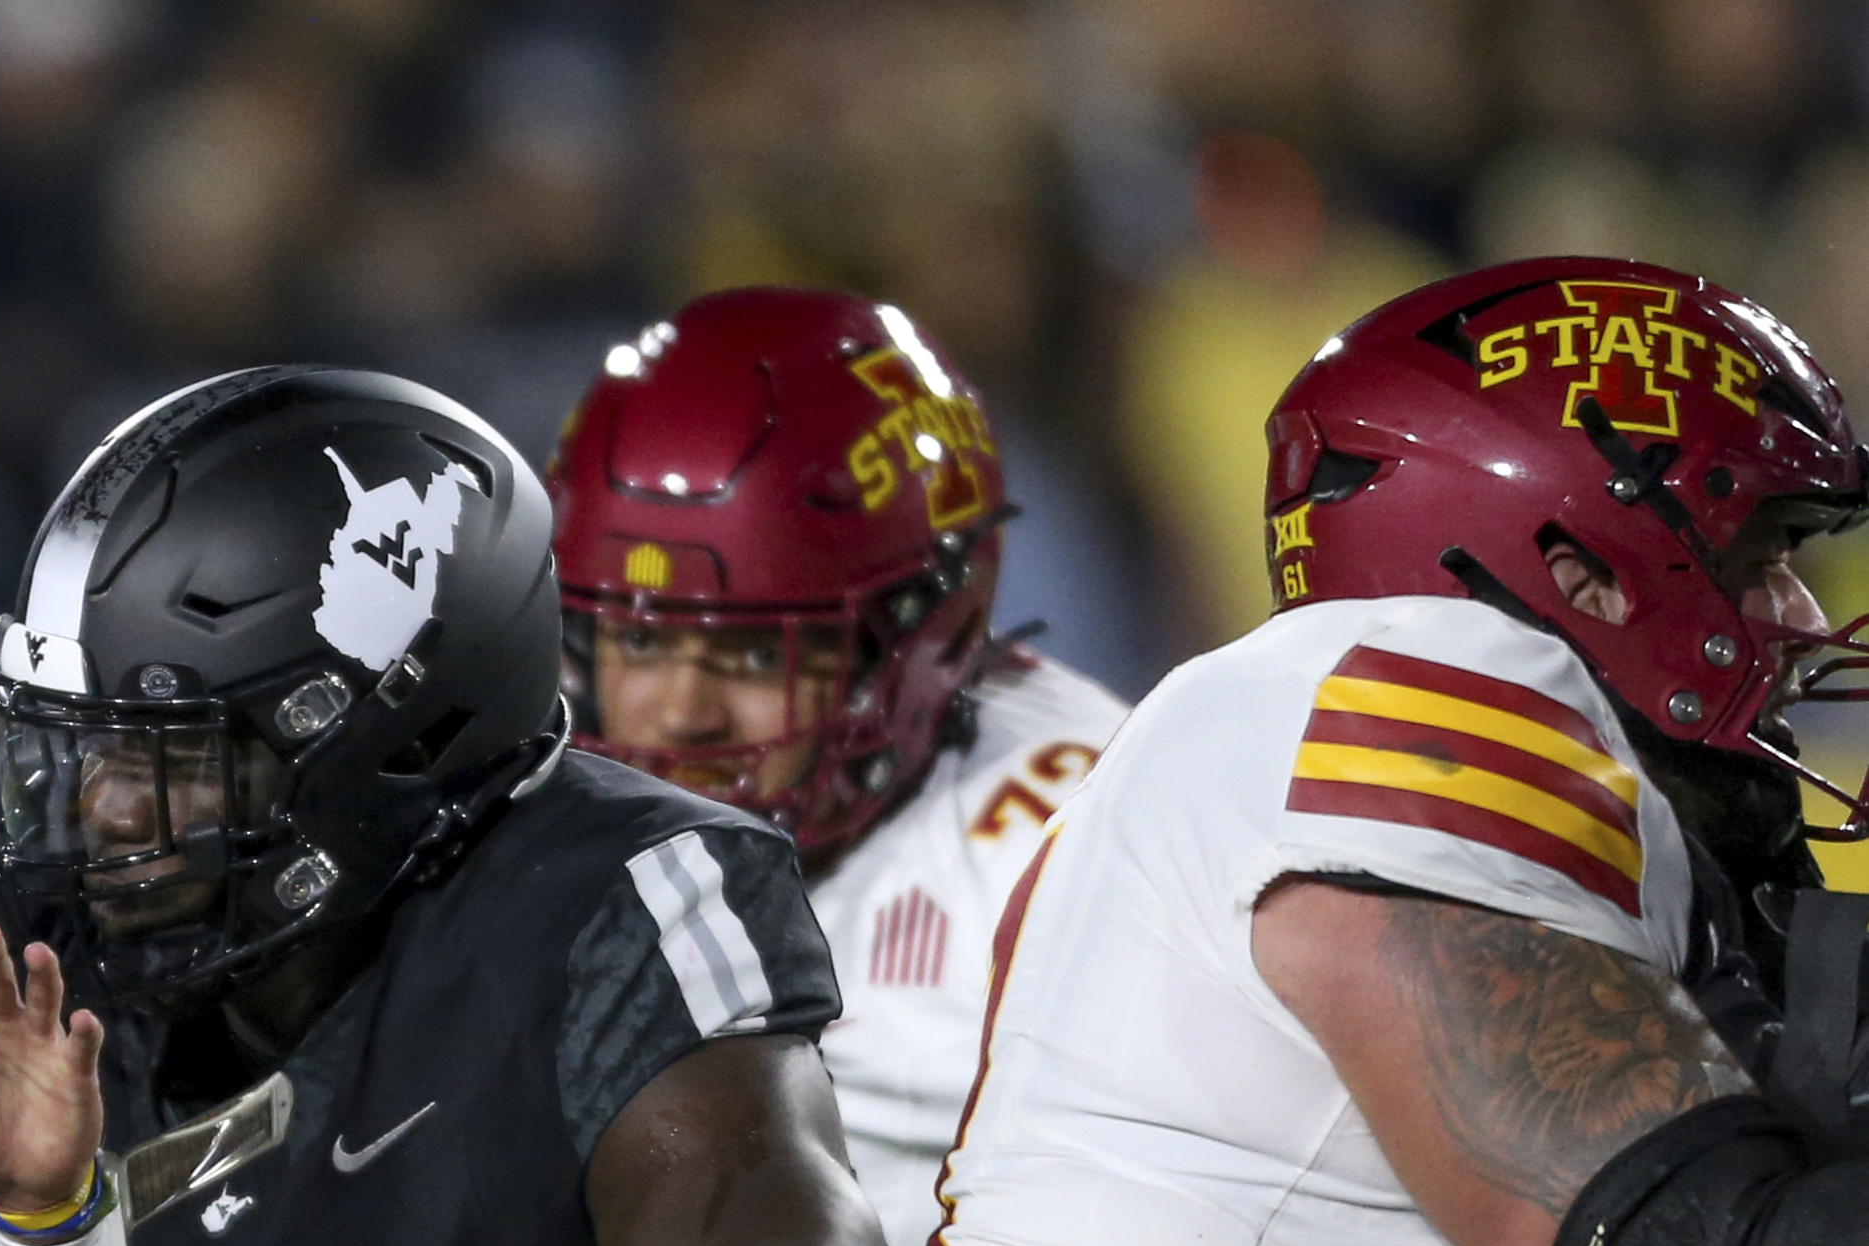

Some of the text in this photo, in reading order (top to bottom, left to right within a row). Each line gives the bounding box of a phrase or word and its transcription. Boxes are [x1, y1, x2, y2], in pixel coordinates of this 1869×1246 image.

[1478, 315, 1759, 416] STATE
[1271, 502, 1314, 559] XII
[1283, 561, 1308, 600] 61
